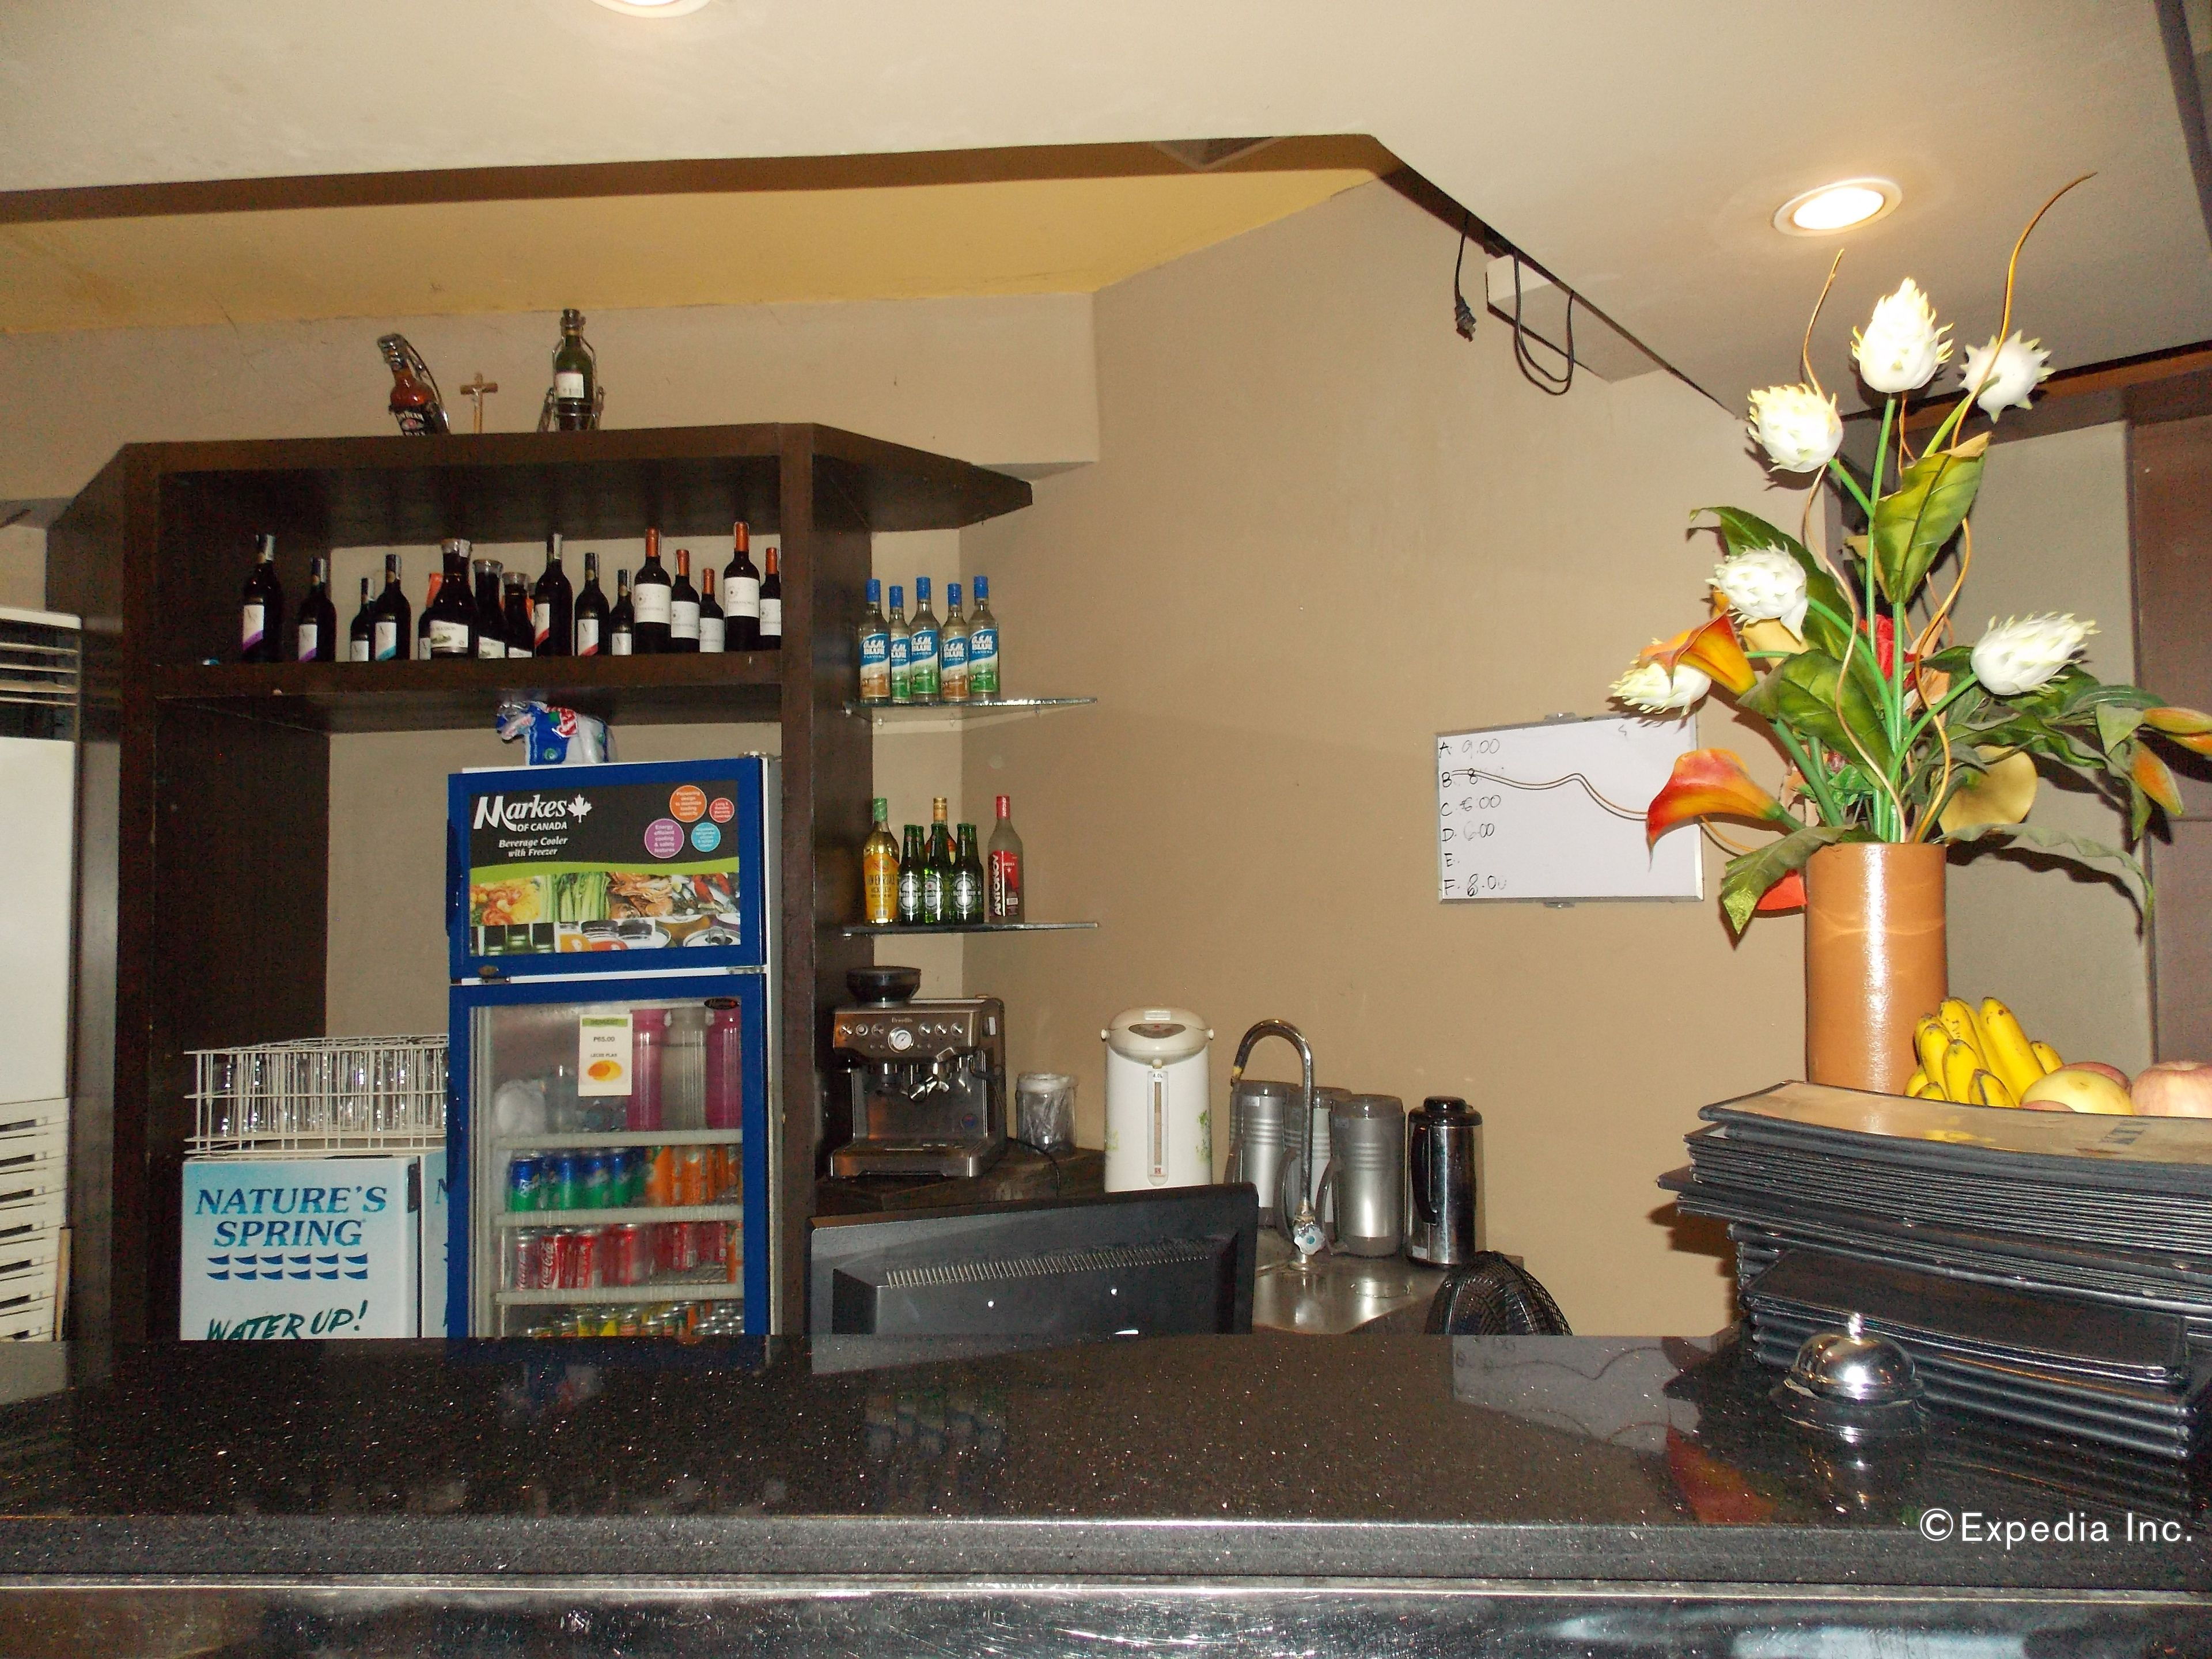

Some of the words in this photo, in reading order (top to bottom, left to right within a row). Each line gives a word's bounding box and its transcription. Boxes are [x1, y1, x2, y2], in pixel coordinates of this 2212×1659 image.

[473, 794, 568, 832] Markes
[517, 823, 530, 832] OF
[531, 822, 568, 831] CANADA
[498, 839, 539, 849] Beverage
[540, 836, 569, 846] Cooler
[508, 850, 526, 858] with
[528, 848, 558, 857] Freezer
[993, 854, 1001, 916] ANTONOV
[195, 1185, 387, 1215] NATURE'S
[213, 1219, 362, 1247] SPRING
[207, 1313, 305, 1340] WATER
[309, 1300, 369, 1336] UP!
